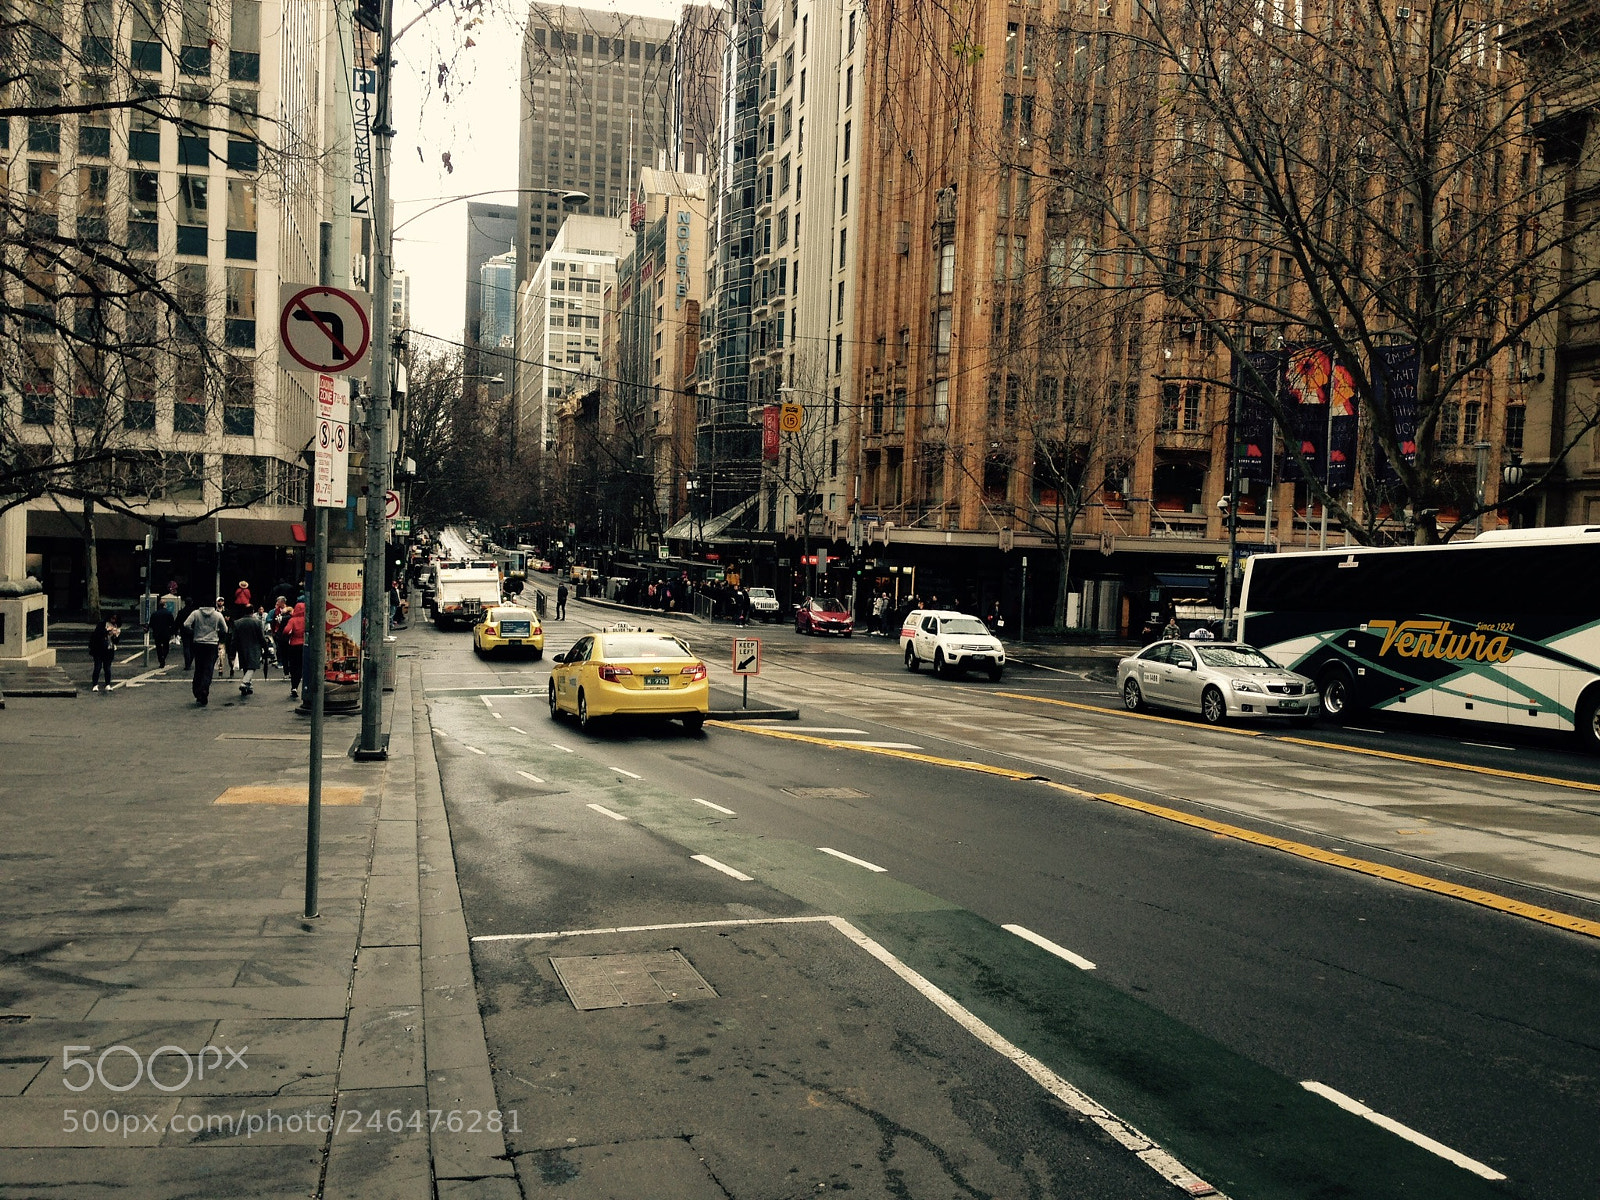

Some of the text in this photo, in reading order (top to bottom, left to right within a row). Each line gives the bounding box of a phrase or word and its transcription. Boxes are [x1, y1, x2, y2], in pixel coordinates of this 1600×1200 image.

[355, 73, 371, 92] P
[354, 98, 371, 185] PARKING
[786, 417, 795, 426] 15
[1476, 622, 1515, 632] Since 1924
[1367, 619, 1515, 663] Ventura
